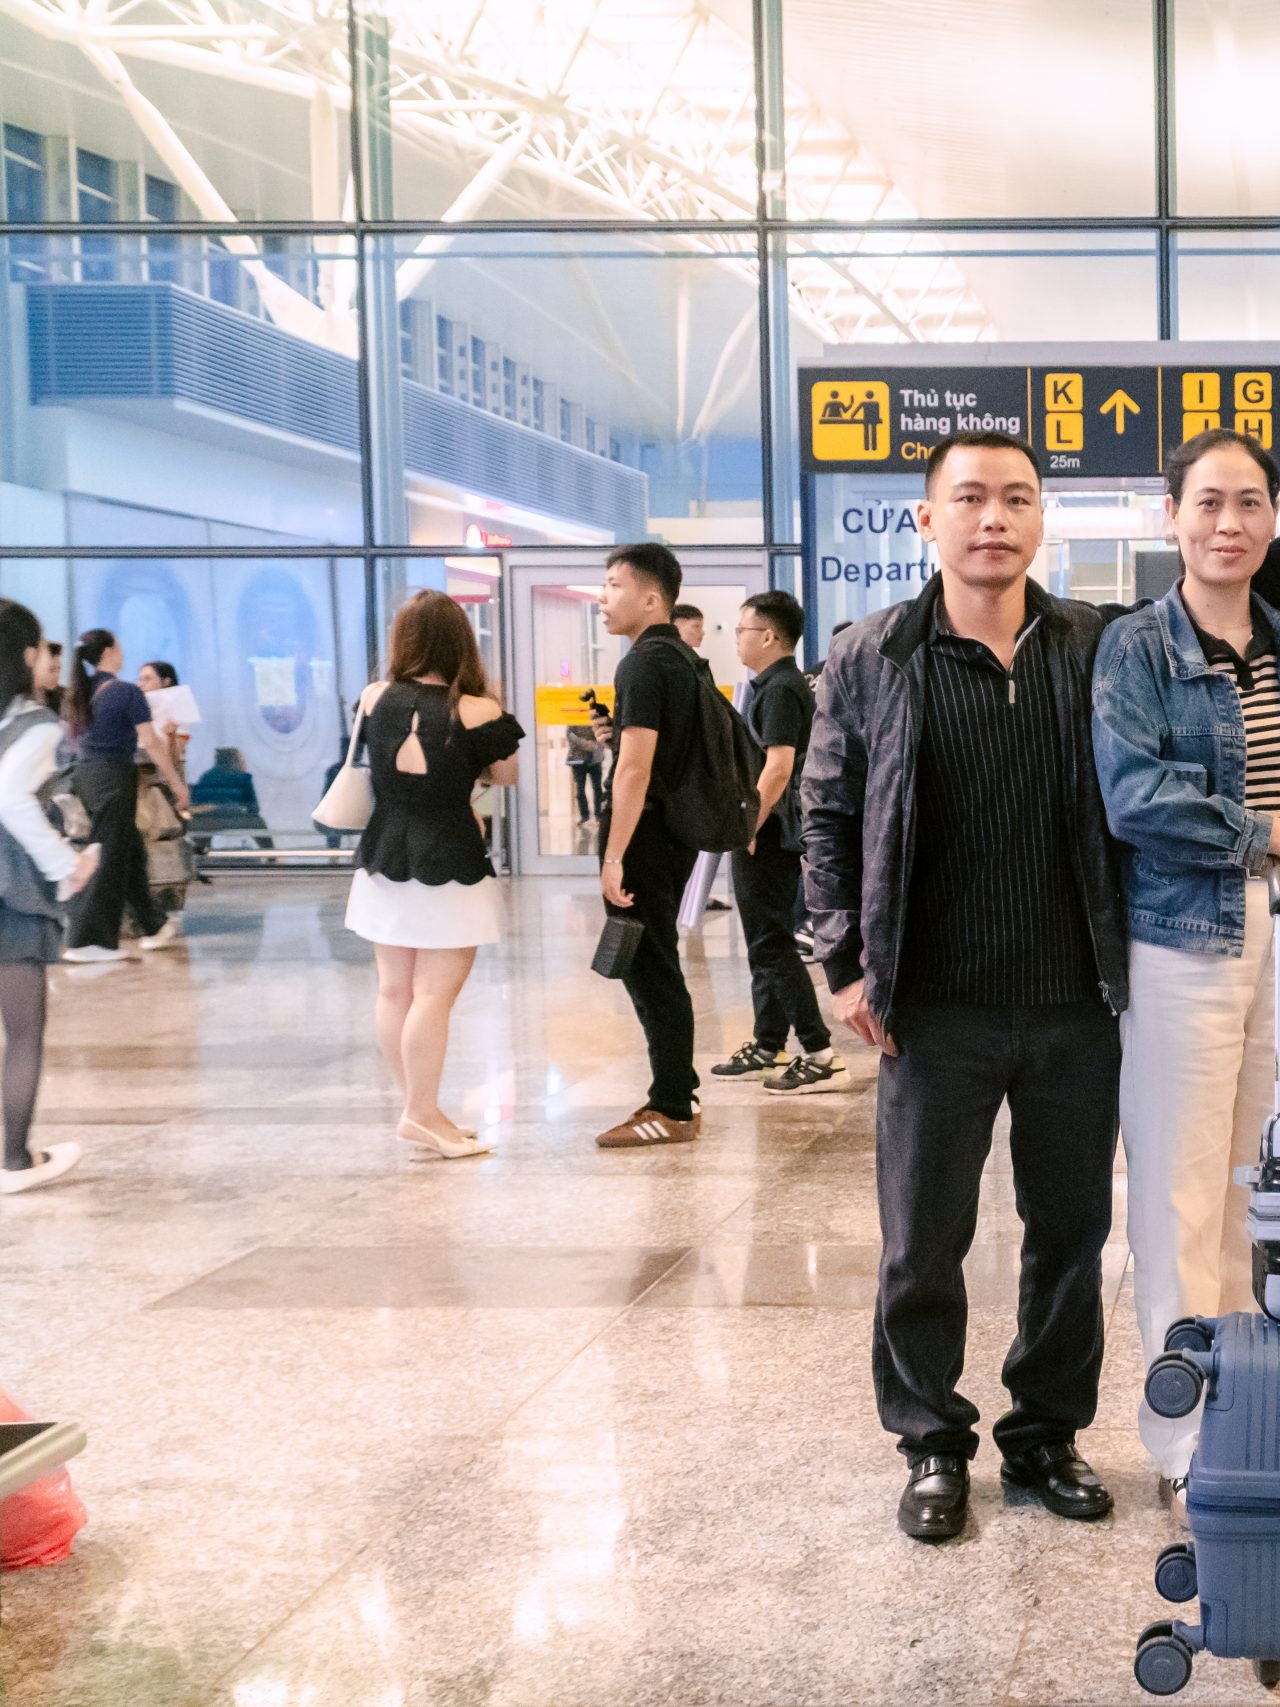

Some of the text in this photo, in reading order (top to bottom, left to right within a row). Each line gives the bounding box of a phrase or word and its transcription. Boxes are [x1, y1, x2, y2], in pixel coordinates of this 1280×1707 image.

[899, 388, 977, 411] Thủ tục
[1053, 380, 1073, 404] K
[1242, 379, 1265, 404] G
[900, 412, 1020, 435] hàng không
[1056, 420, 1073, 444] L
[1050, 455, 1080, 469] 25m
[842, 499, 918, 534] CỬA
